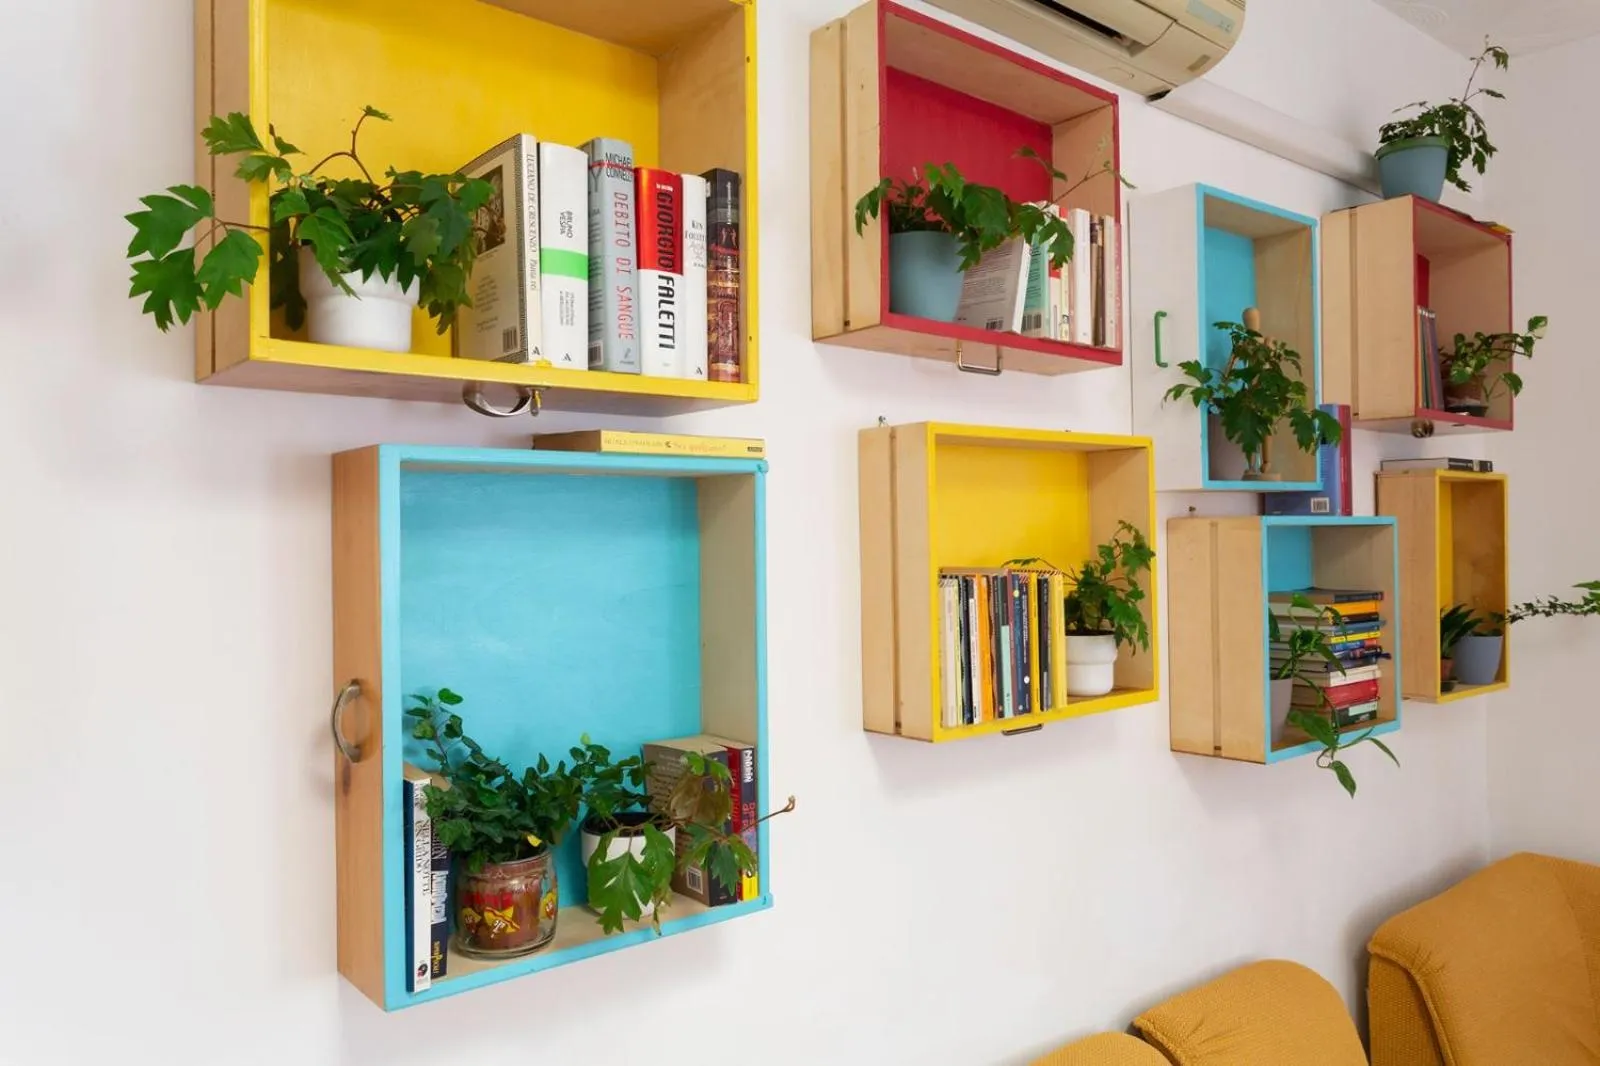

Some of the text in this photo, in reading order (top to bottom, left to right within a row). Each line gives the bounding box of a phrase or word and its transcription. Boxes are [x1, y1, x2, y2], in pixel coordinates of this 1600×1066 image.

[526, 153, 535, 191] LUCIANO
[527, 192, 535, 204] DE
[528, 205, 537, 254] CRESCENZO
[614, 192, 632, 248] DEBITO
[656, 191, 675, 272] GIORGIO
[616, 257, 632, 274] DI
[616, 285, 634, 340] SANGUE
[657, 274, 676, 349] FALETTI
